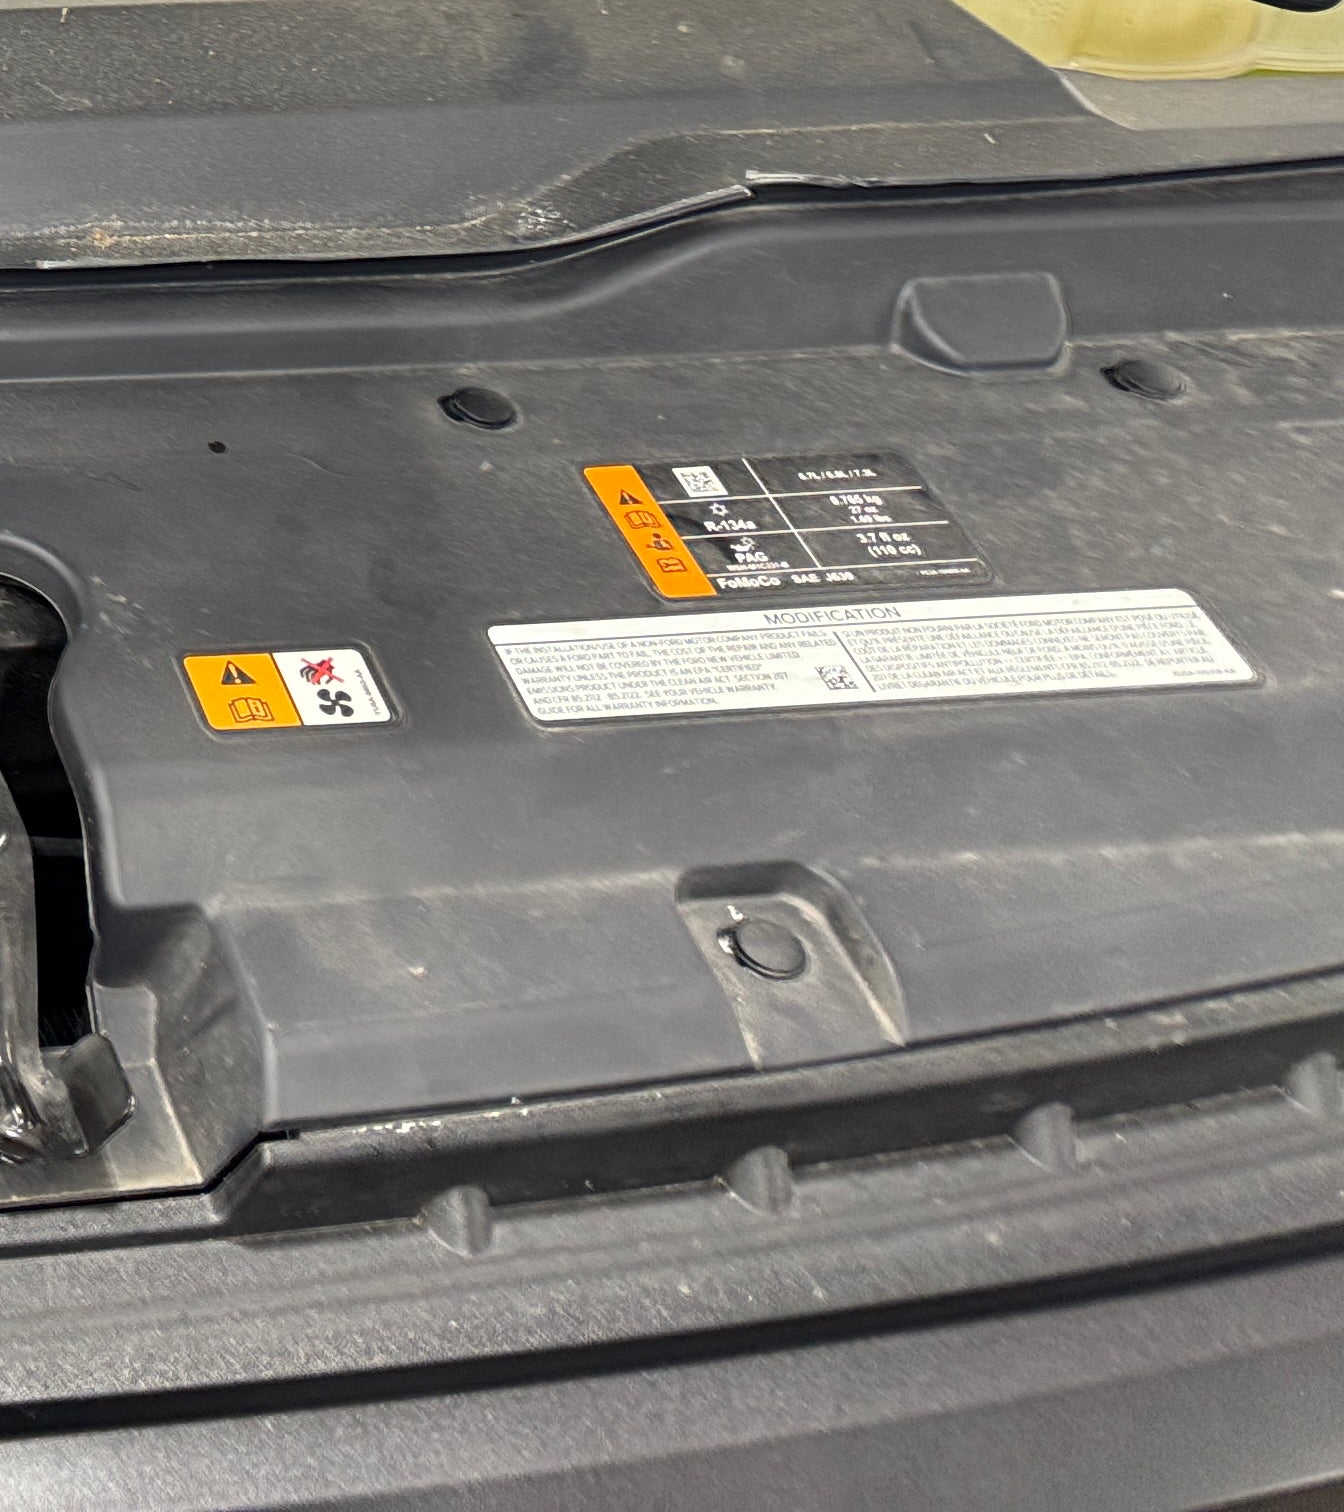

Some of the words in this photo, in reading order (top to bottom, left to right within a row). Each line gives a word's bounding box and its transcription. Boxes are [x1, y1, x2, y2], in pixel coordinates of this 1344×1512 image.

[862, 494, 883, 506] kg
[703, 519, 757, 532] R-134a
[856, 532, 877, 543] 3.7
[892, 532, 911, 541] oz
[734, 551, 769, 563] PAG
[868, 544, 897, 558] (110
[898, 543, 922, 556] cc)
[716, 575, 781, 589] FoMoCo
[791, 573, 821, 584] SAE
[764, 607, 901, 625] MODIFICATION
[514, 646, 532, 654] THE
[683, 636, 716, 644] MOTOR
[715, 634, 757, 642] COMPANY
[759, 631, 799, 639] PRODUCT
[509, 657, 523, 665] OR
[523, 655, 559, 664] CAUSES
[559, 654, 566, 662] A
[566, 653, 591, 661] FORD
[591, 651, 614, 659] PART
[651, 648, 670, 656] THE
[515, 665, 553, 674] DAMAGE
[554, 664, 576, 672] WILL
[575, 663, 594, 671] NOT
[595, 662, 608, 670] BE
[608, 660, 649, 669] COVERED
[662, 657, 681, 665] THE
[681, 656, 706, 664] FORD
[705, 655, 727, 663] NEW
[728, 652, 764, 661] VEHICLE
[521, 674, 570, 684] WARRANTY
[626, 668, 667, 677] PRODUCT
[649, 678, 667, 686] THE
[725, 682, 775, 692] WARRANTY
[565, 704, 584, 713] FOR
[602, 700, 652, 710] WARRANTY
